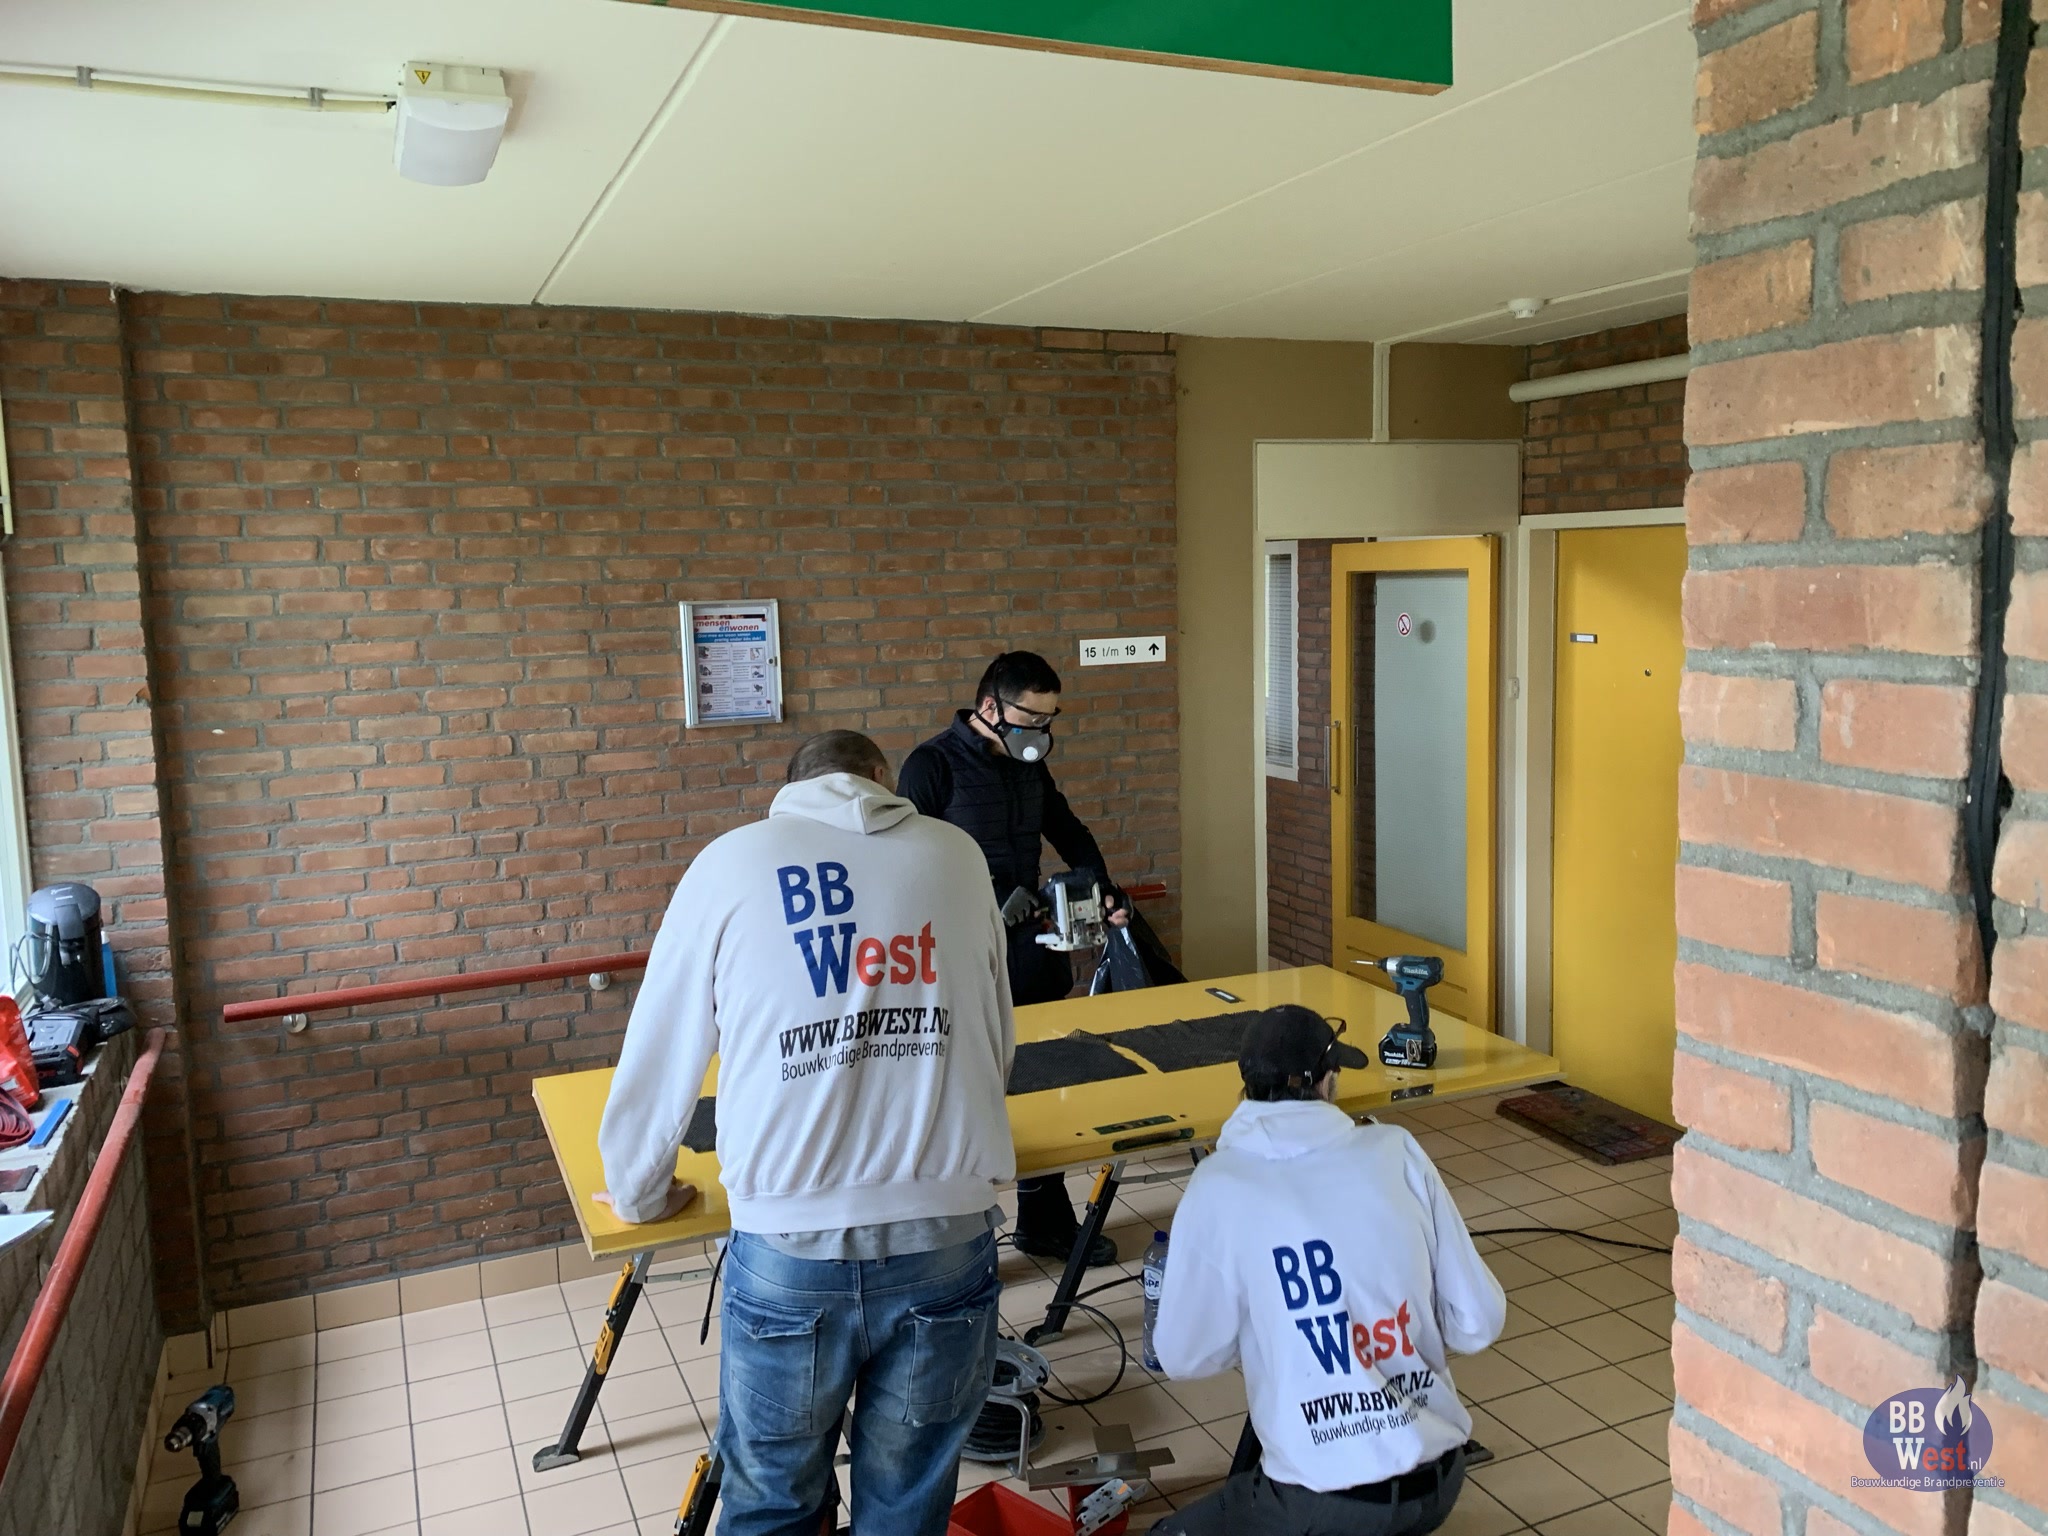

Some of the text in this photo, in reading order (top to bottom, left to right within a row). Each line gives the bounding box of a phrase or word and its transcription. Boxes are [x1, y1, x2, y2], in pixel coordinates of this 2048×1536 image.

[1085, 645, 1136, 658] 15 t/m 19
[777, 861, 854, 925] BB
[794, 921, 937, 998] West
[1403, 967, 1429, 976] Makita
[779, 1007, 950, 1059] WWW.BBWEST.NL
[782, 1045, 862, 1082] Bouwkundige
[1272, 1239, 1342, 1311] BB
[1295, 1299, 1415, 1375] West
[1311, 1414, 1387, 1446] Bouwkundige
